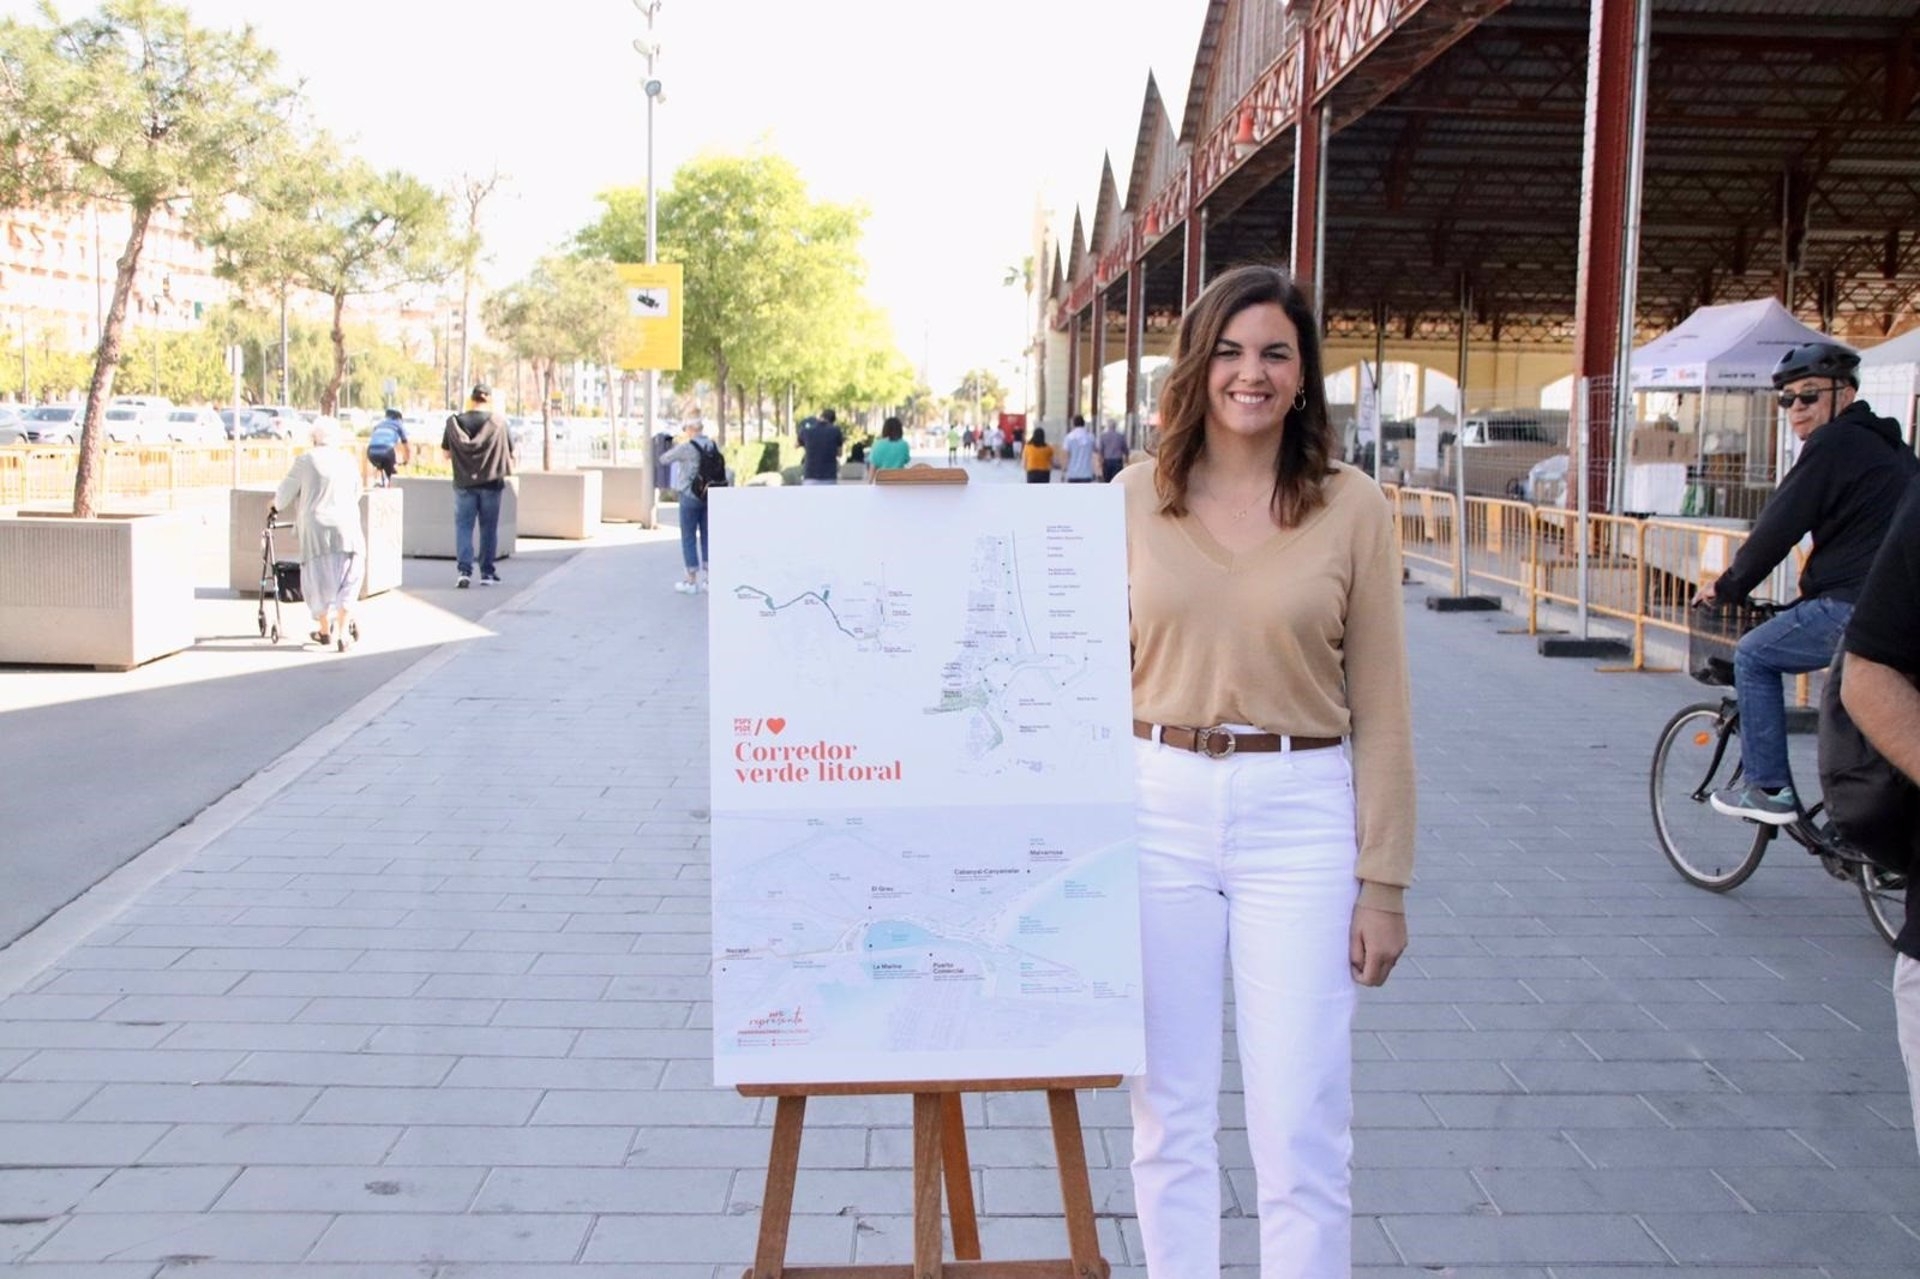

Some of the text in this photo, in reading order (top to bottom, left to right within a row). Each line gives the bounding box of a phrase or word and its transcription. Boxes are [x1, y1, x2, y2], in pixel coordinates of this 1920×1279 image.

[735, 741, 857, 762] Corredor
[735, 760, 902, 783] verde litoral
